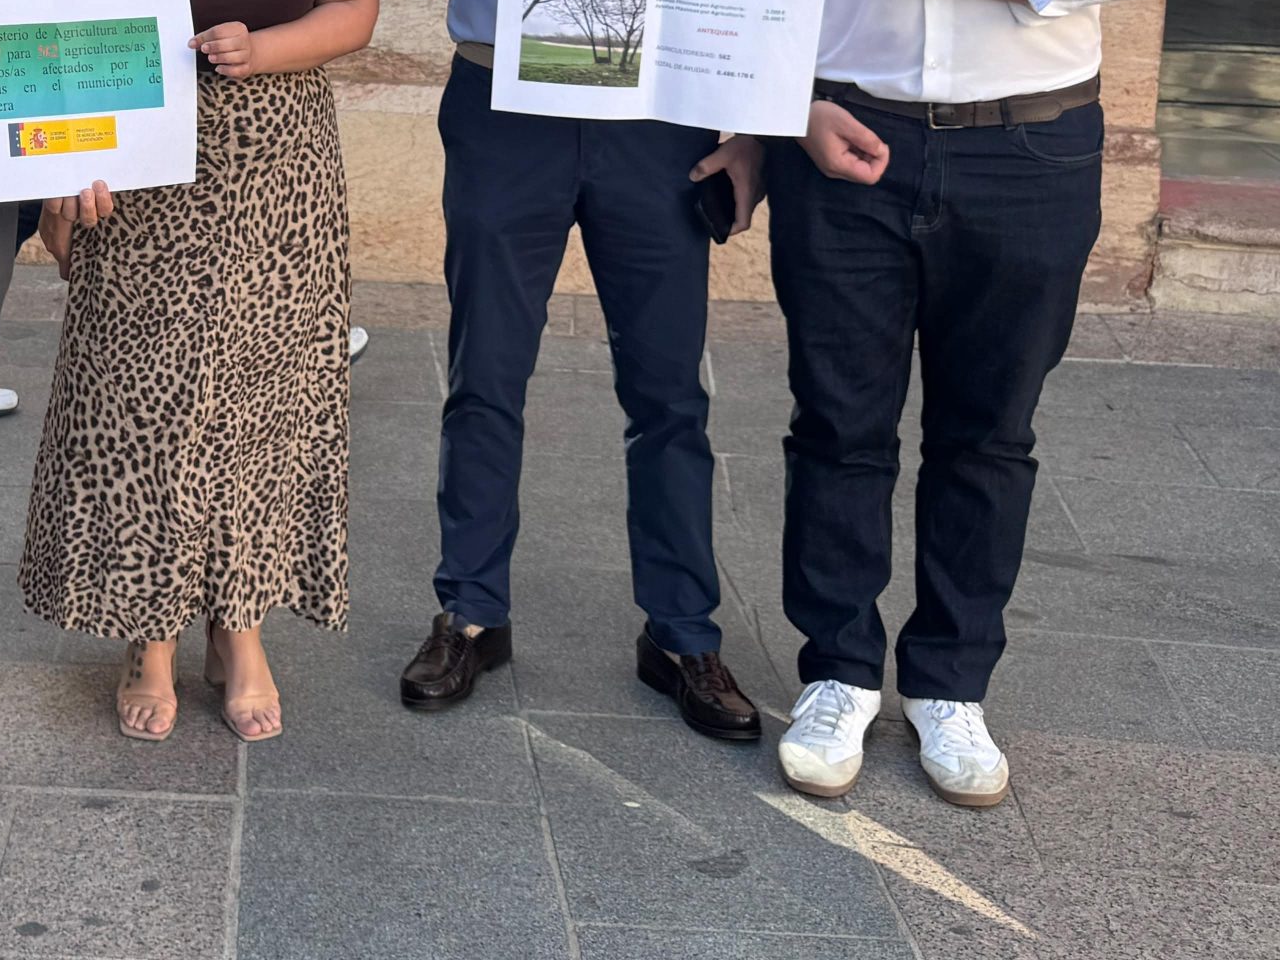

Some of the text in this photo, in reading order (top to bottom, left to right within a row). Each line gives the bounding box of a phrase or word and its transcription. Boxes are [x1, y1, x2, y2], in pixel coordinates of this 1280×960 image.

[35, 28, 47, 39] de
[54, 24, 117, 41] Agricultura
[124, 22, 157, 34] abona
[7, 50, 31, 63] para
[64, 41, 145, 57] agricultores/as
[152, 43, 159, 53] y
[42, 62, 94, 75] afectados
[110, 61, 128, 73] por
[145, 56, 160, 68] las
[24, 84, 37, 93] en
[52, 80, 61, 91] el
[77, 77, 133, 89] municipio
[149, 73, 161, 84] de
